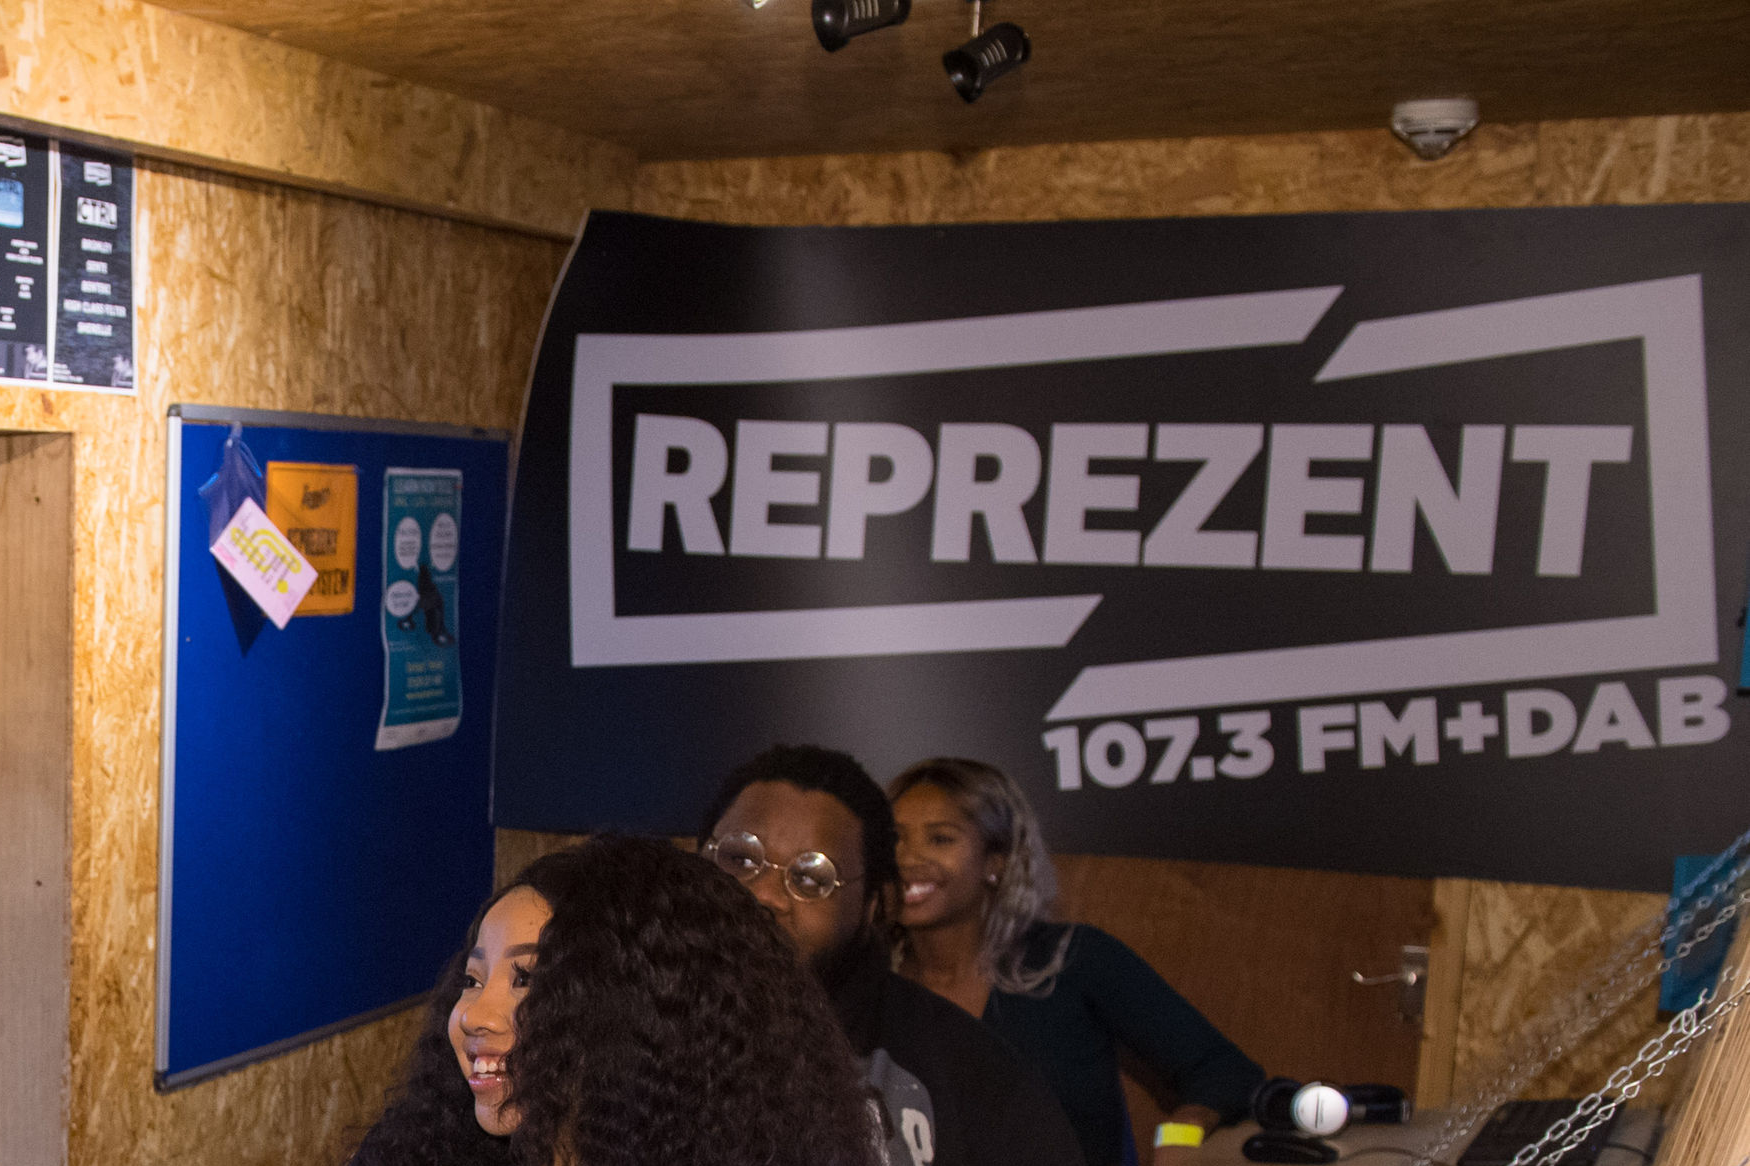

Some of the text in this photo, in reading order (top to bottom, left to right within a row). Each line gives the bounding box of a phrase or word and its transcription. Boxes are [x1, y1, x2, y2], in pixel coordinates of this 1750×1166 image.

[79, 198, 117, 227] CTRL
[627, 413, 1634, 577] REPREZENT
[1043, 675, 1731, 791] 107.3 FM+DAB
